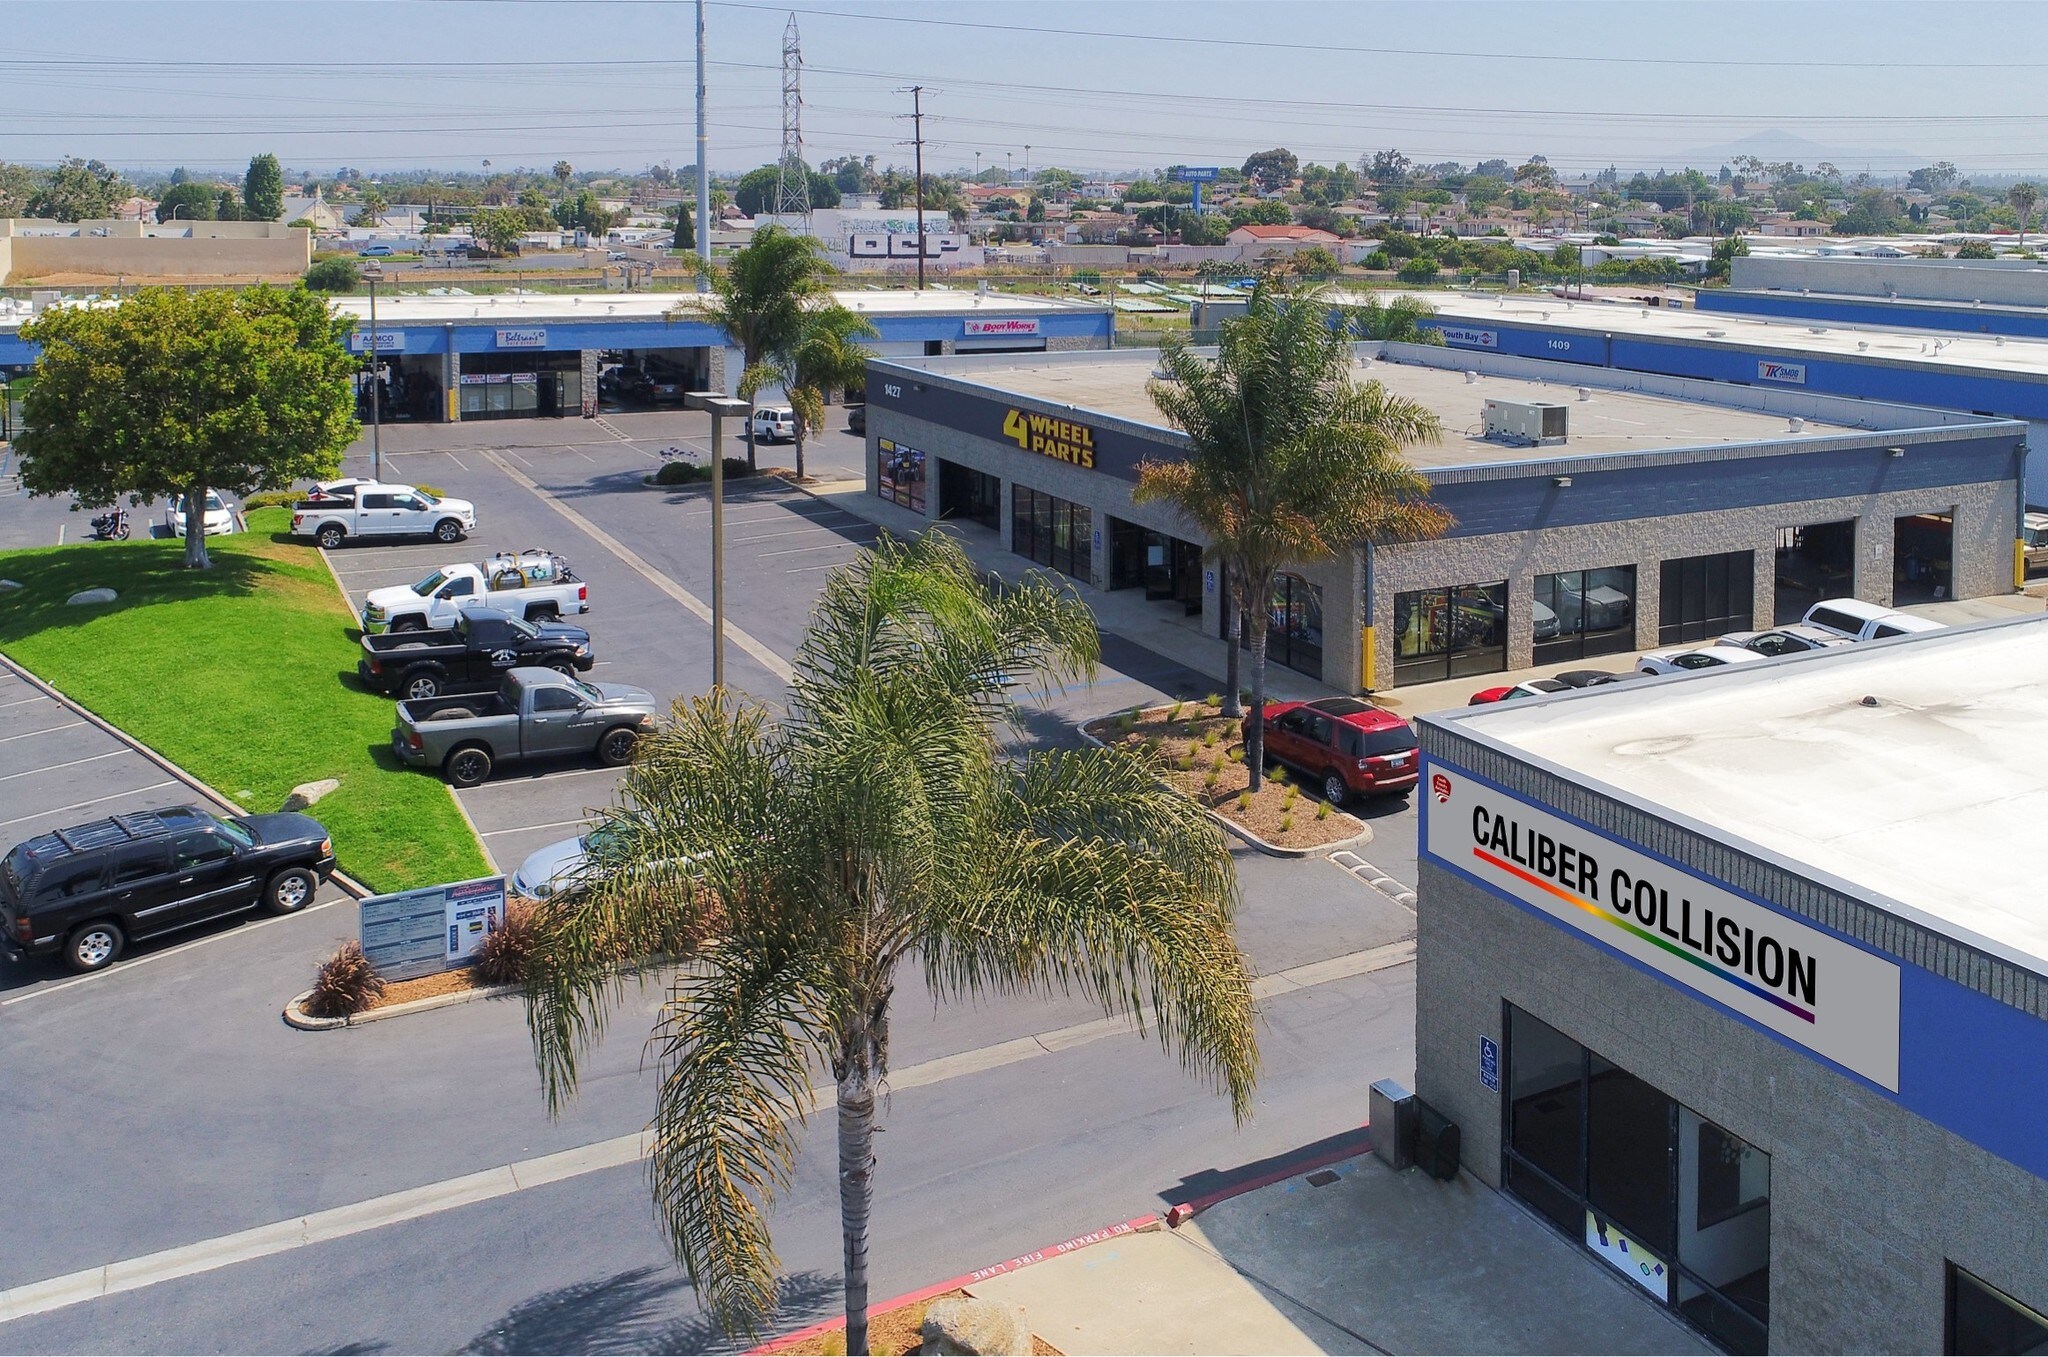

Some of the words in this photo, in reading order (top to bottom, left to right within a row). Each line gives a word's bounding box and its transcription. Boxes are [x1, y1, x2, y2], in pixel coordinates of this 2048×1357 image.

[1443, 329, 1463, 340] South
[1464, 332, 1479, 343] Bay
[1548, 339, 1570, 351] 1409
[1780, 368, 1799, 378] SMOG
[884, 383, 901, 399] 1427
[1003, 409, 1028, 449] 4
[1029, 414, 1093, 448] WHEEL
[1032, 435, 1093, 468] PARTS
[1472, 805, 1599, 901] CALIBER
[1611, 869, 1816, 1007] COLLISION
[1114, 1223, 1130, 1232] NO
[1057, 1230, 1110, 1253] PARKING
[1013, 1251, 1043, 1267] FIRE
[971, 1263, 1006, 1281] LANE
